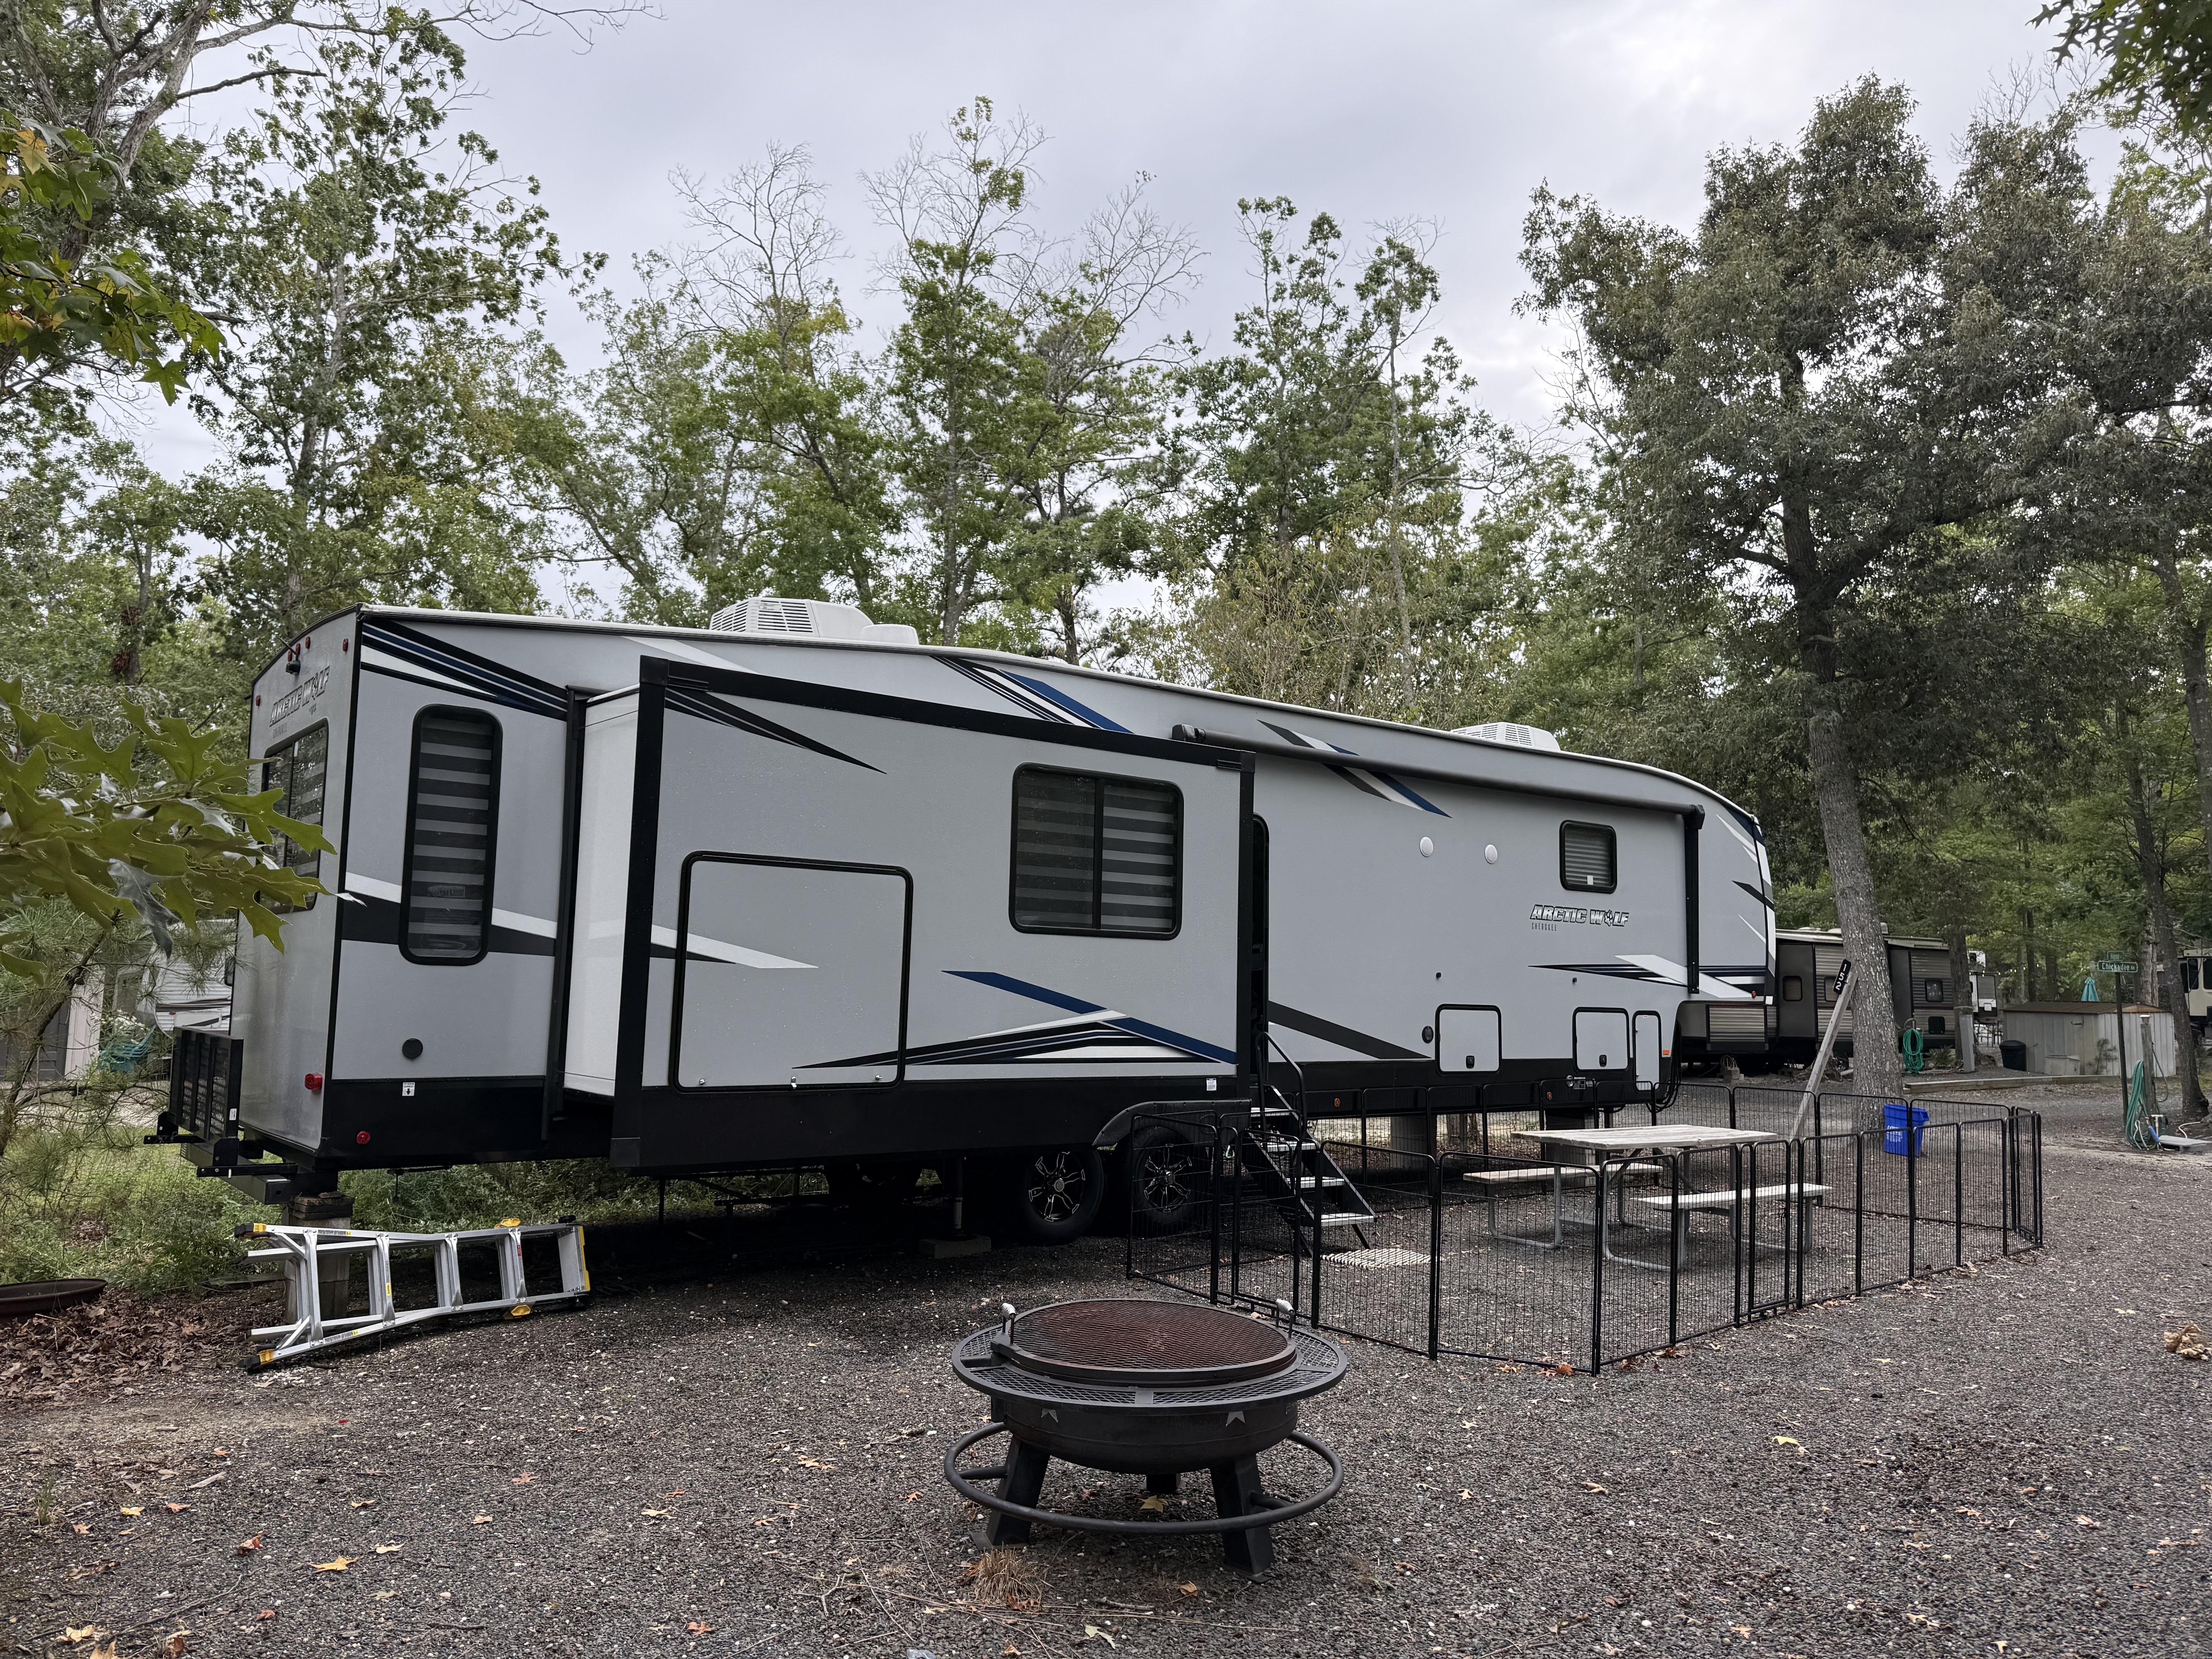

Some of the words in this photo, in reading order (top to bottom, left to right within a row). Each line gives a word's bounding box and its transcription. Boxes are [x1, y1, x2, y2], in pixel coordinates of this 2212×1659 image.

[270, 685, 302, 728] ARCTIC
[1530, 904, 1587, 924] ARCTIC
[1532, 922, 1556, 931] CHEROKEE
[2102, 962, 2130, 971] Chickadee
[1836, 964, 1847, 990] 152
